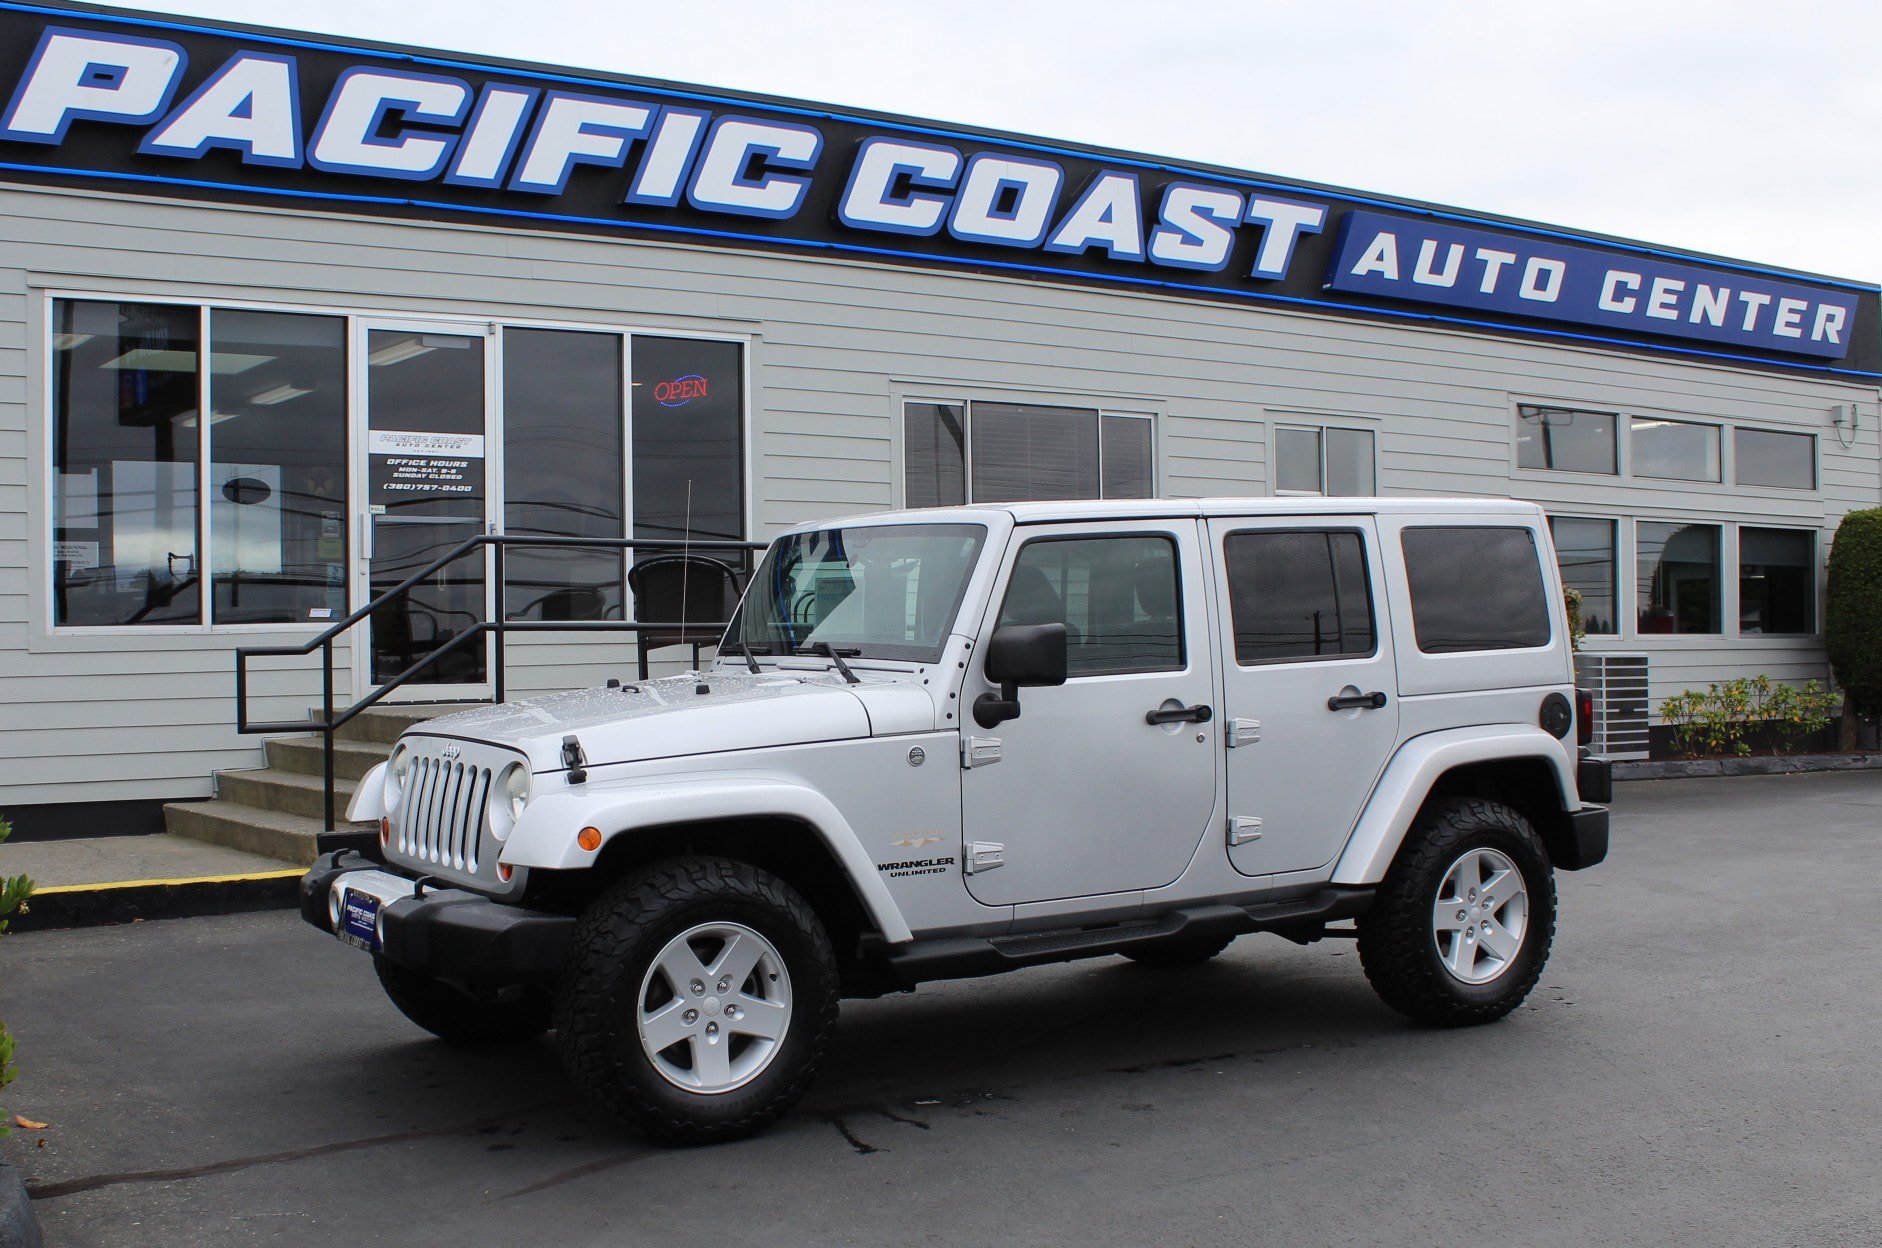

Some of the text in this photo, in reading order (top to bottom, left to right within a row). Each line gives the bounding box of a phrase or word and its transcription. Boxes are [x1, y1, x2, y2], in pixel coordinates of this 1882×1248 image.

[2, 26, 1328, 281] PACIFIC COAST
[1350, 231, 1847, 345] AUTO CENTER
[654, 379, 708, 401] OPEN
[380, 434, 472, 446] PACIFIC COAST
[386, 458, 469, 468] OFFICE HOURS
[877, 857, 955, 871] WRANGLER
[890, 867, 946, 878] UNLIMITED
